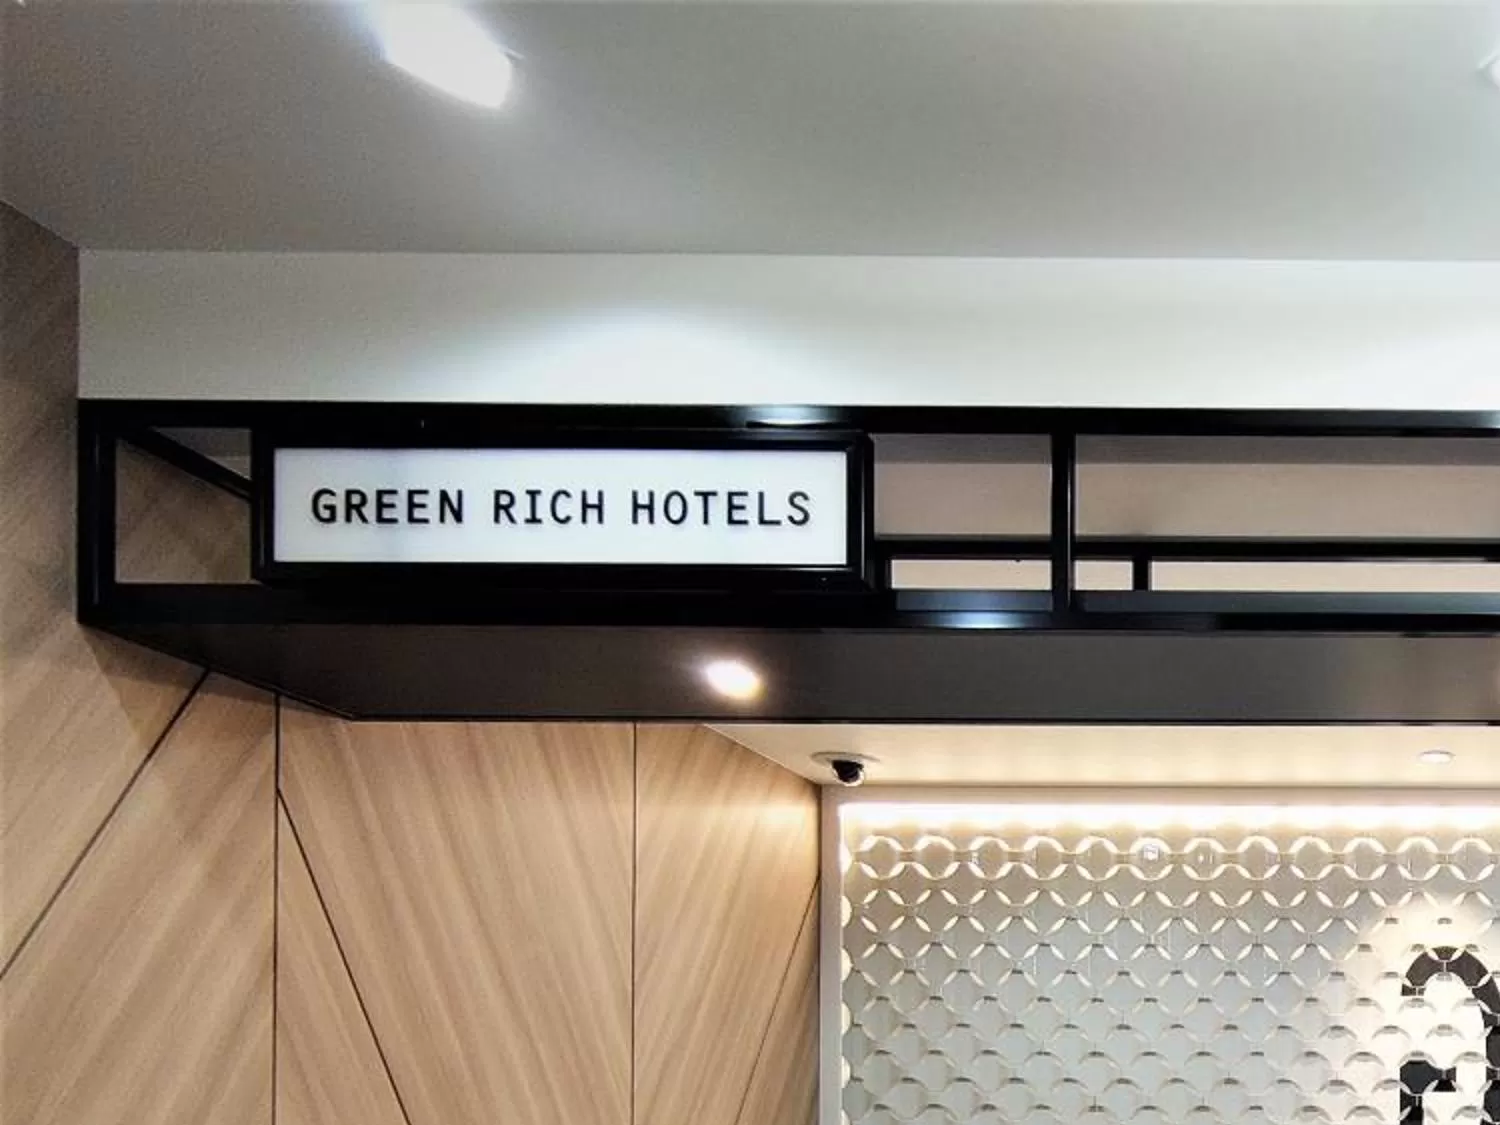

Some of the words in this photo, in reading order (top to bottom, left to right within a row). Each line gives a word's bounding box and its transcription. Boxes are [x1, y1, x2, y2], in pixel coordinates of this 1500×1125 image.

[310, 487, 464, 525] GREEN
[492, 489, 605, 526] RICH
[631, 490, 811, 527] HOTELS
